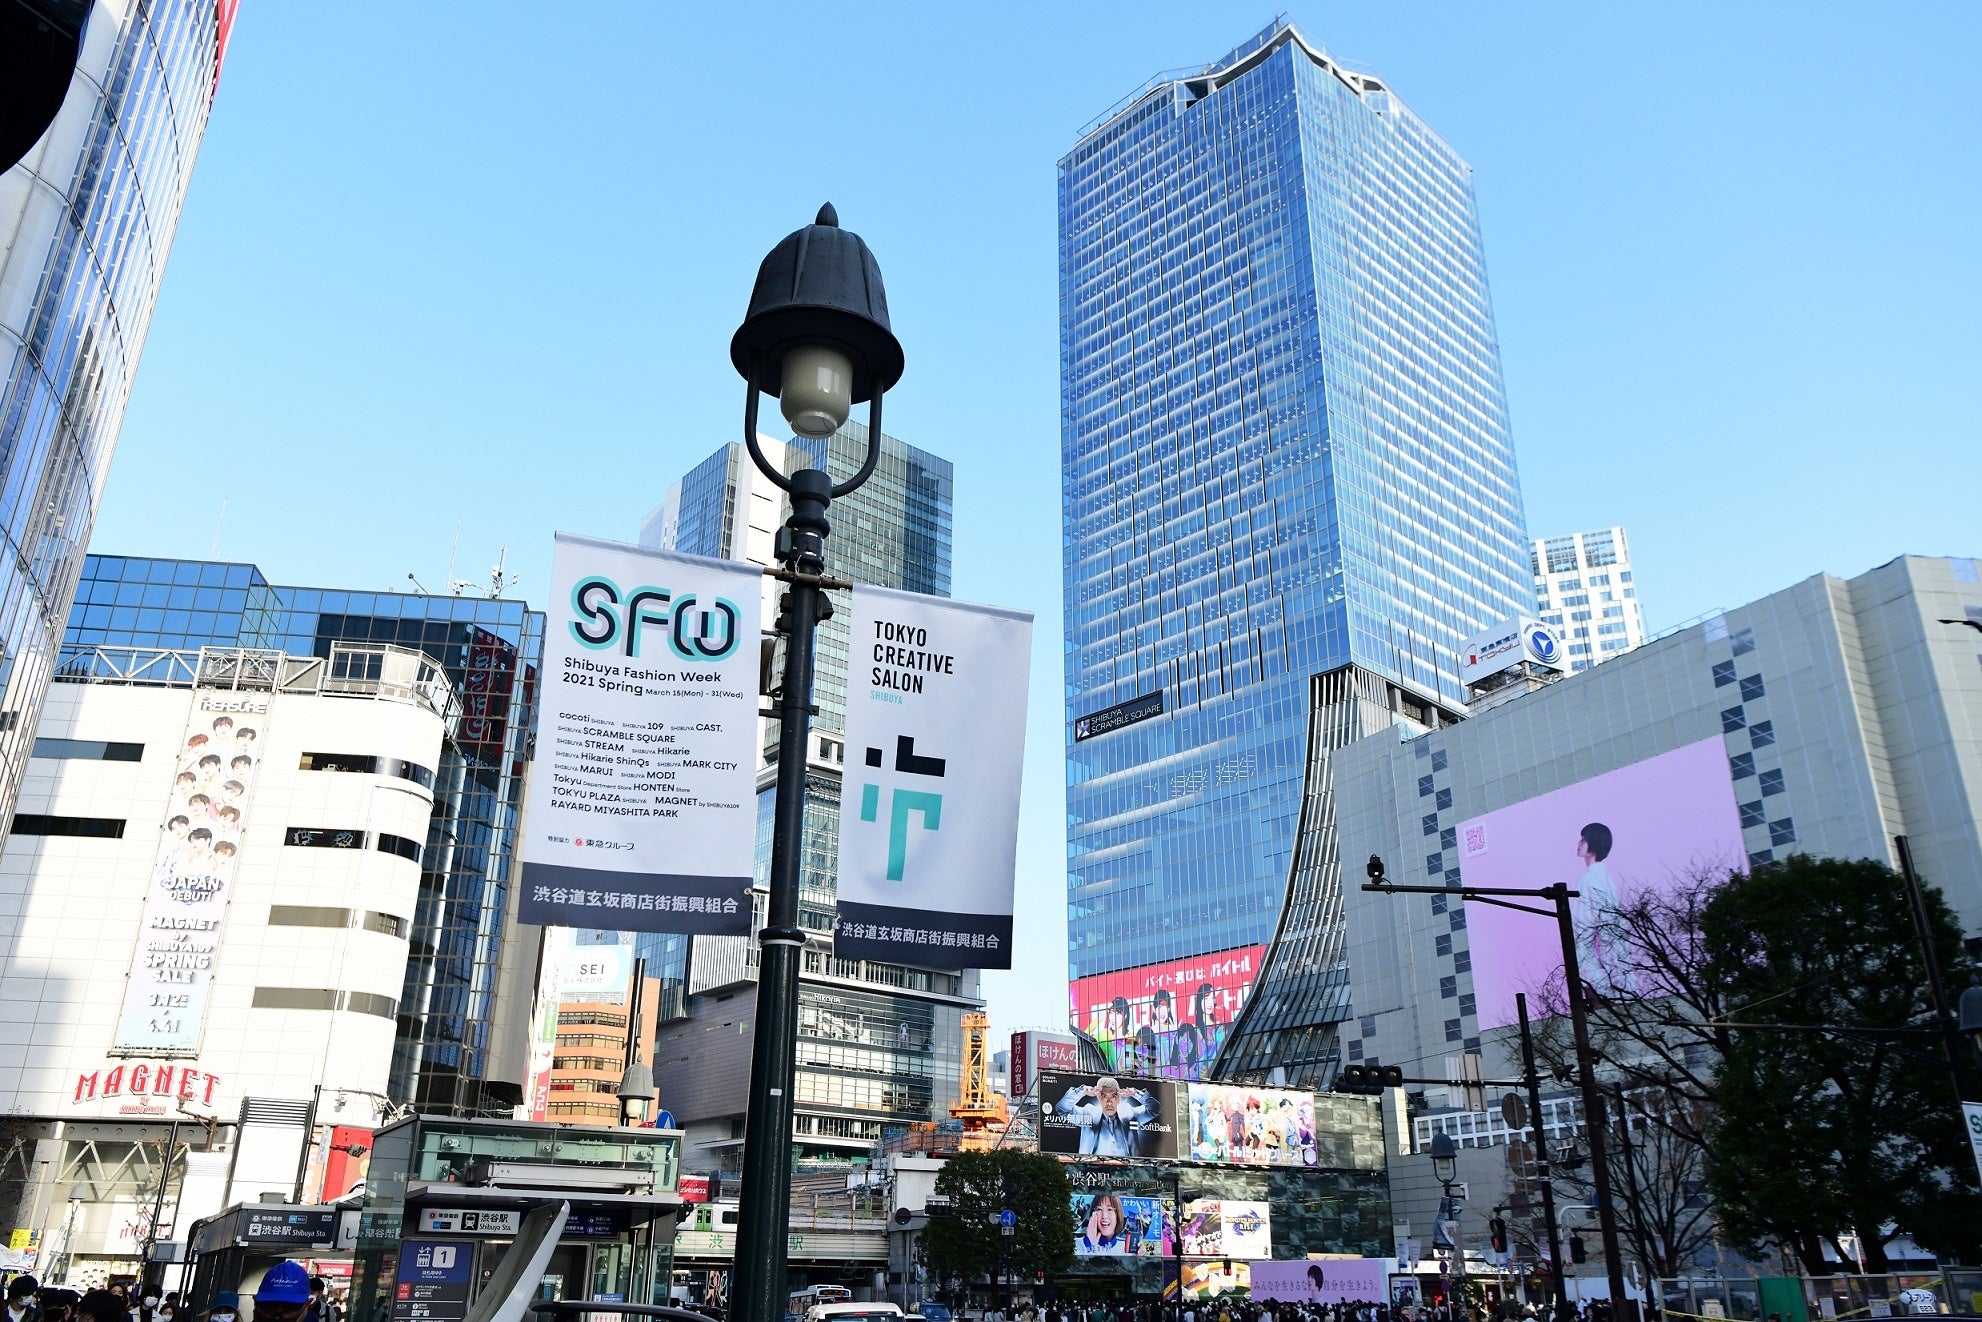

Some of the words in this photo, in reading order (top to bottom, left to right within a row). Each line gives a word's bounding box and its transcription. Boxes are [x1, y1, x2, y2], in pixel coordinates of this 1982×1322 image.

[568, 575, 741, 662] SFW
[874, 621, 927, 647] TOKYO
[873, 644, 954, 675] CREATIVE
[1479, 640, 1521, 662] TOKYU
[564, 657, 619, 676] Shibuya
[624, 667, 676, 682] Fashion
[681, 671, 721, 683] Week
[563, 672, 594, 687] 2021
[599, 678, 643, 696] Spring
[646, 688, 671, 697] March
[712, 690, 744, 700] 31(Wed)
[871, 667, 924, 694] SALON
[870, 690, 903, 704] SHIBUYA
[200, 700, 267, 714] TREASURE
[559, 712, 591, 723] cocoti
[647, 722, 664, 731] 109
[695, 723, 723, 733] CAST.
[1091, 708, 1123, 725] SHIBUYA
[1091, 716, 1130, 734] SCRAMBLE
[1131, 703, 1162, 721] SQUARE
[583, 727, 635, 741] SCRAMBLE
[637, 733, 676, 744] SQUARE
[584, 740, 624, 752] STREAM
[657, 747, 690, 756] Hikarie
[581, 752, 614, 764] Hikarie
[616, 756, 650, 767] ShinQs
[683, 759, 711, 769] MARK
[713, 761, 738, 771] CITY
[580, 764, 613, 776] MARUI
[646, 771, 676, 780] MODI
[553, 773, 582, 788] Tokyu
[633, 783, 675, 792] HONTEN
[552, 786, 587, 799] TOKYU
[589, 791, 621, 803] PLAZA
[655, 796, 698, 807] MAGNET
[551, 799, 592, 812] RAYARD
[594, 805, 650, 817] MIYASHITA
[653, 809, 679, 819] PARK
[586, 838, 635, 851] 東急グループ
[169, 876, 222, 891] JAPAN
[532, 884, 739, 914] 渋谷道玄坂商店街振興組合
[150, 916, 220, 931] MAGNET
[842, 921, 1000, 949] 渋谷道玄坂商店街振興組合
[143, 954, 211, 970] SPRING
[580, 964, 605, 975] SEI
[151, 969, 195, 984] SALE
[72, 1064, 221, 1107] MAGNET
[1140, 1122, 1172, 1133] SoftBank
[1072, 1171, 1111, 1187] 渋谷駅
[480, 1213, 509, 1223] 渋谷駅
[1152, 1200, 1161, 1238] 新オトモ
[261, 1223, 292, 1236] 渋谷駅
[292, 1229, 315, 1238] Shibuya
[316, 1229, 327, 1237] Sta.
[479, 1223, 500, 1232] Shibuya
[440, 1250, 448, 1264] 1
